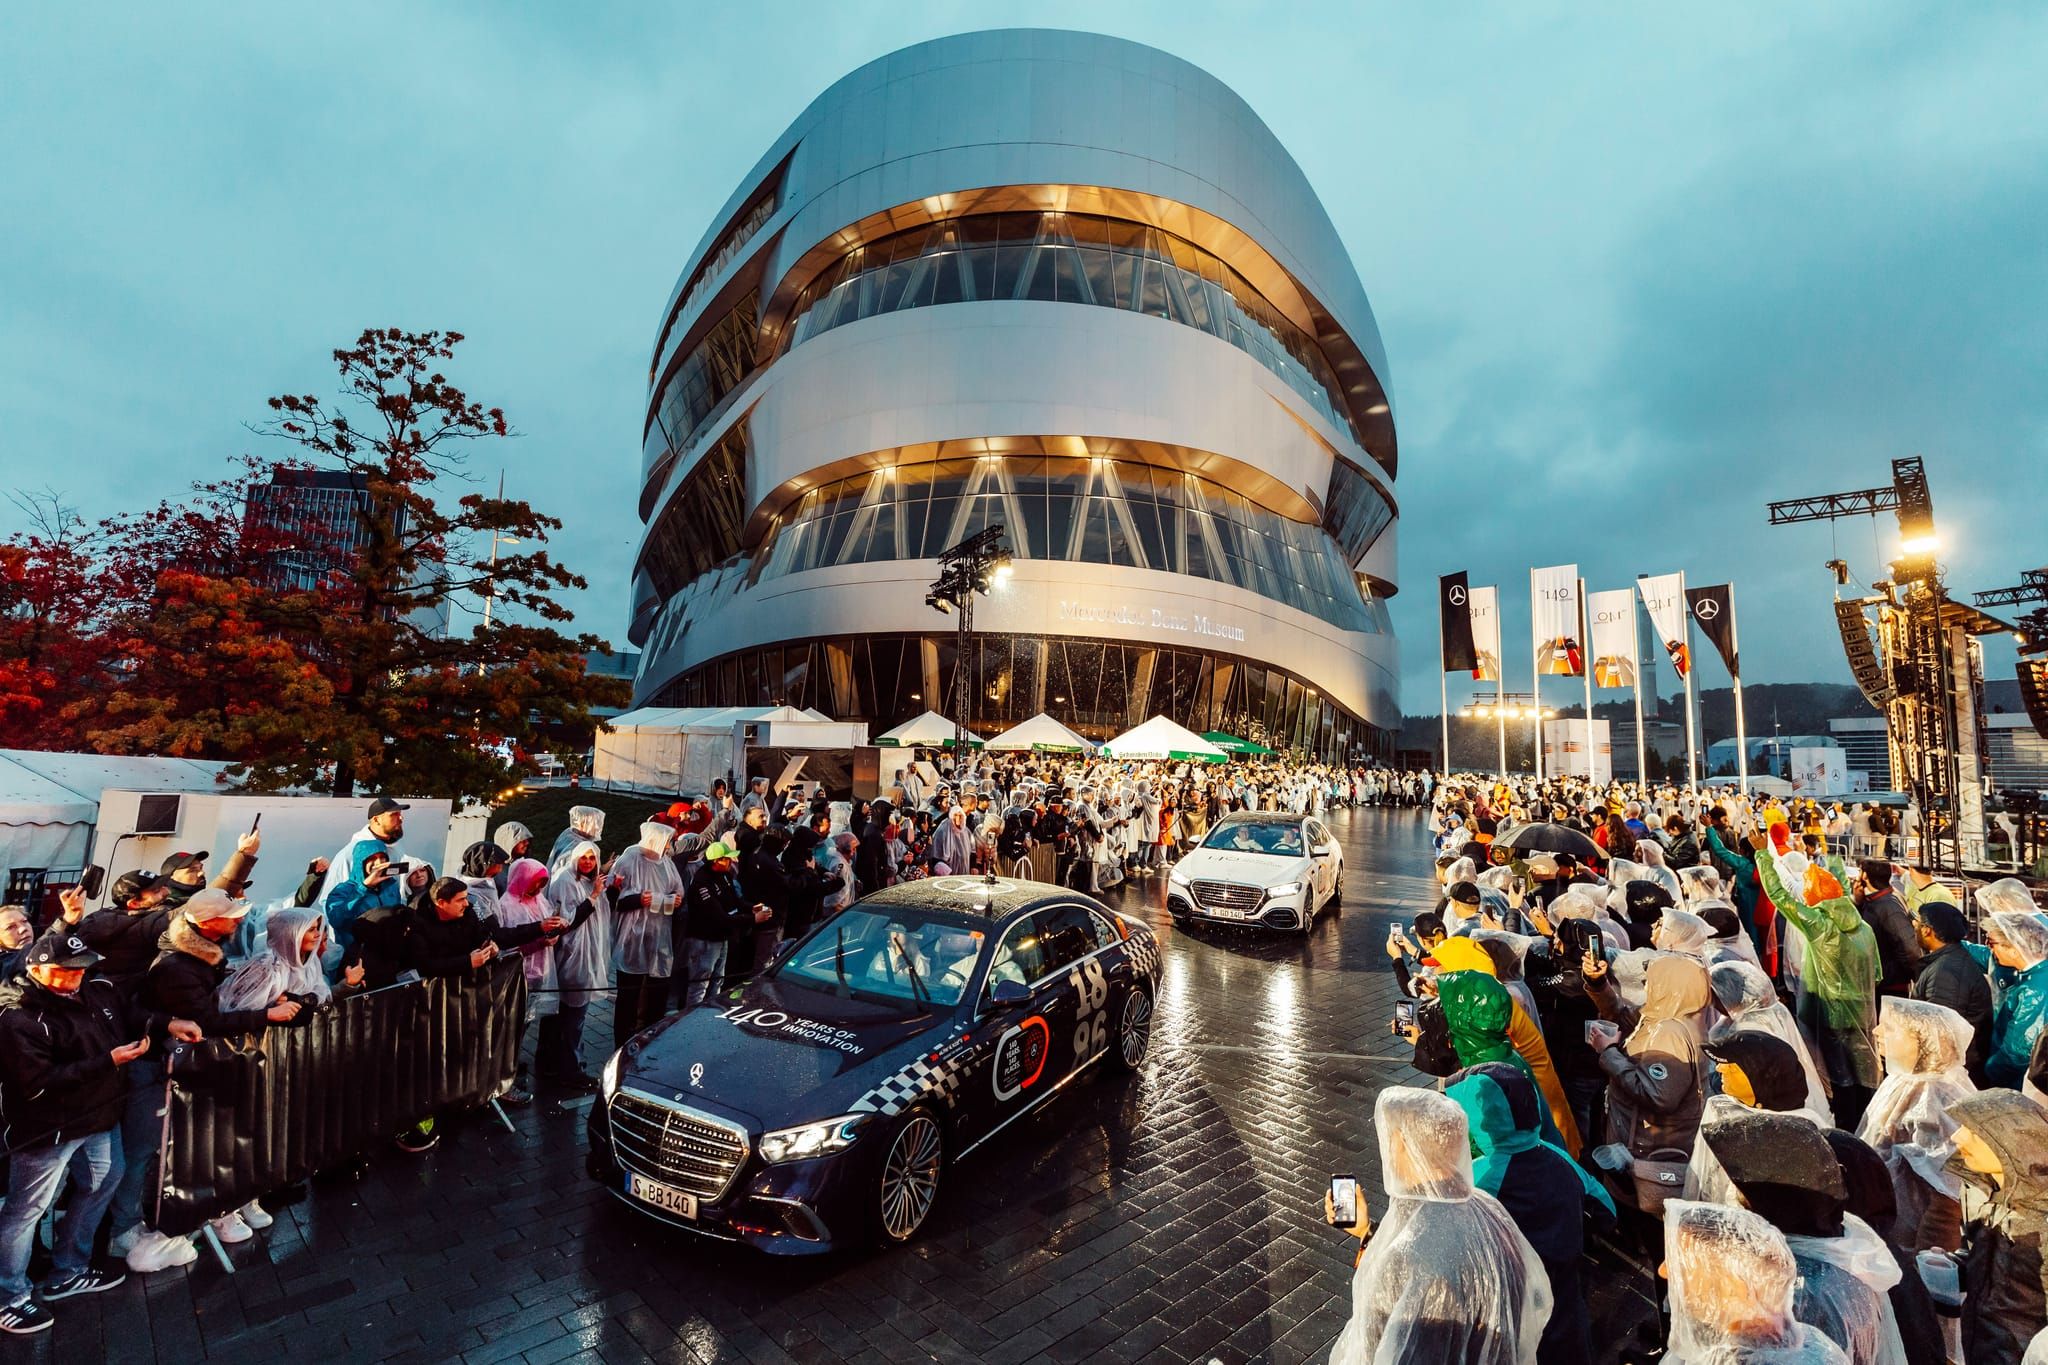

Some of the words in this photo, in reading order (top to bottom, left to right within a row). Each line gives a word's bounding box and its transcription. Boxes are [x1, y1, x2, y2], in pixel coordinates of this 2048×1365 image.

[1193, 615, 1245, 641] Museum
[1069, 957, 1107, 1020] 18
[715, 1005, 788, 1027] 140
[781, 1023, 865, 1055] INNOVATION
[794, 1017, 834, 1035] YEARS
[835, 1030, 857, 1040] OF
[633, 1178, 642, 1196] S
